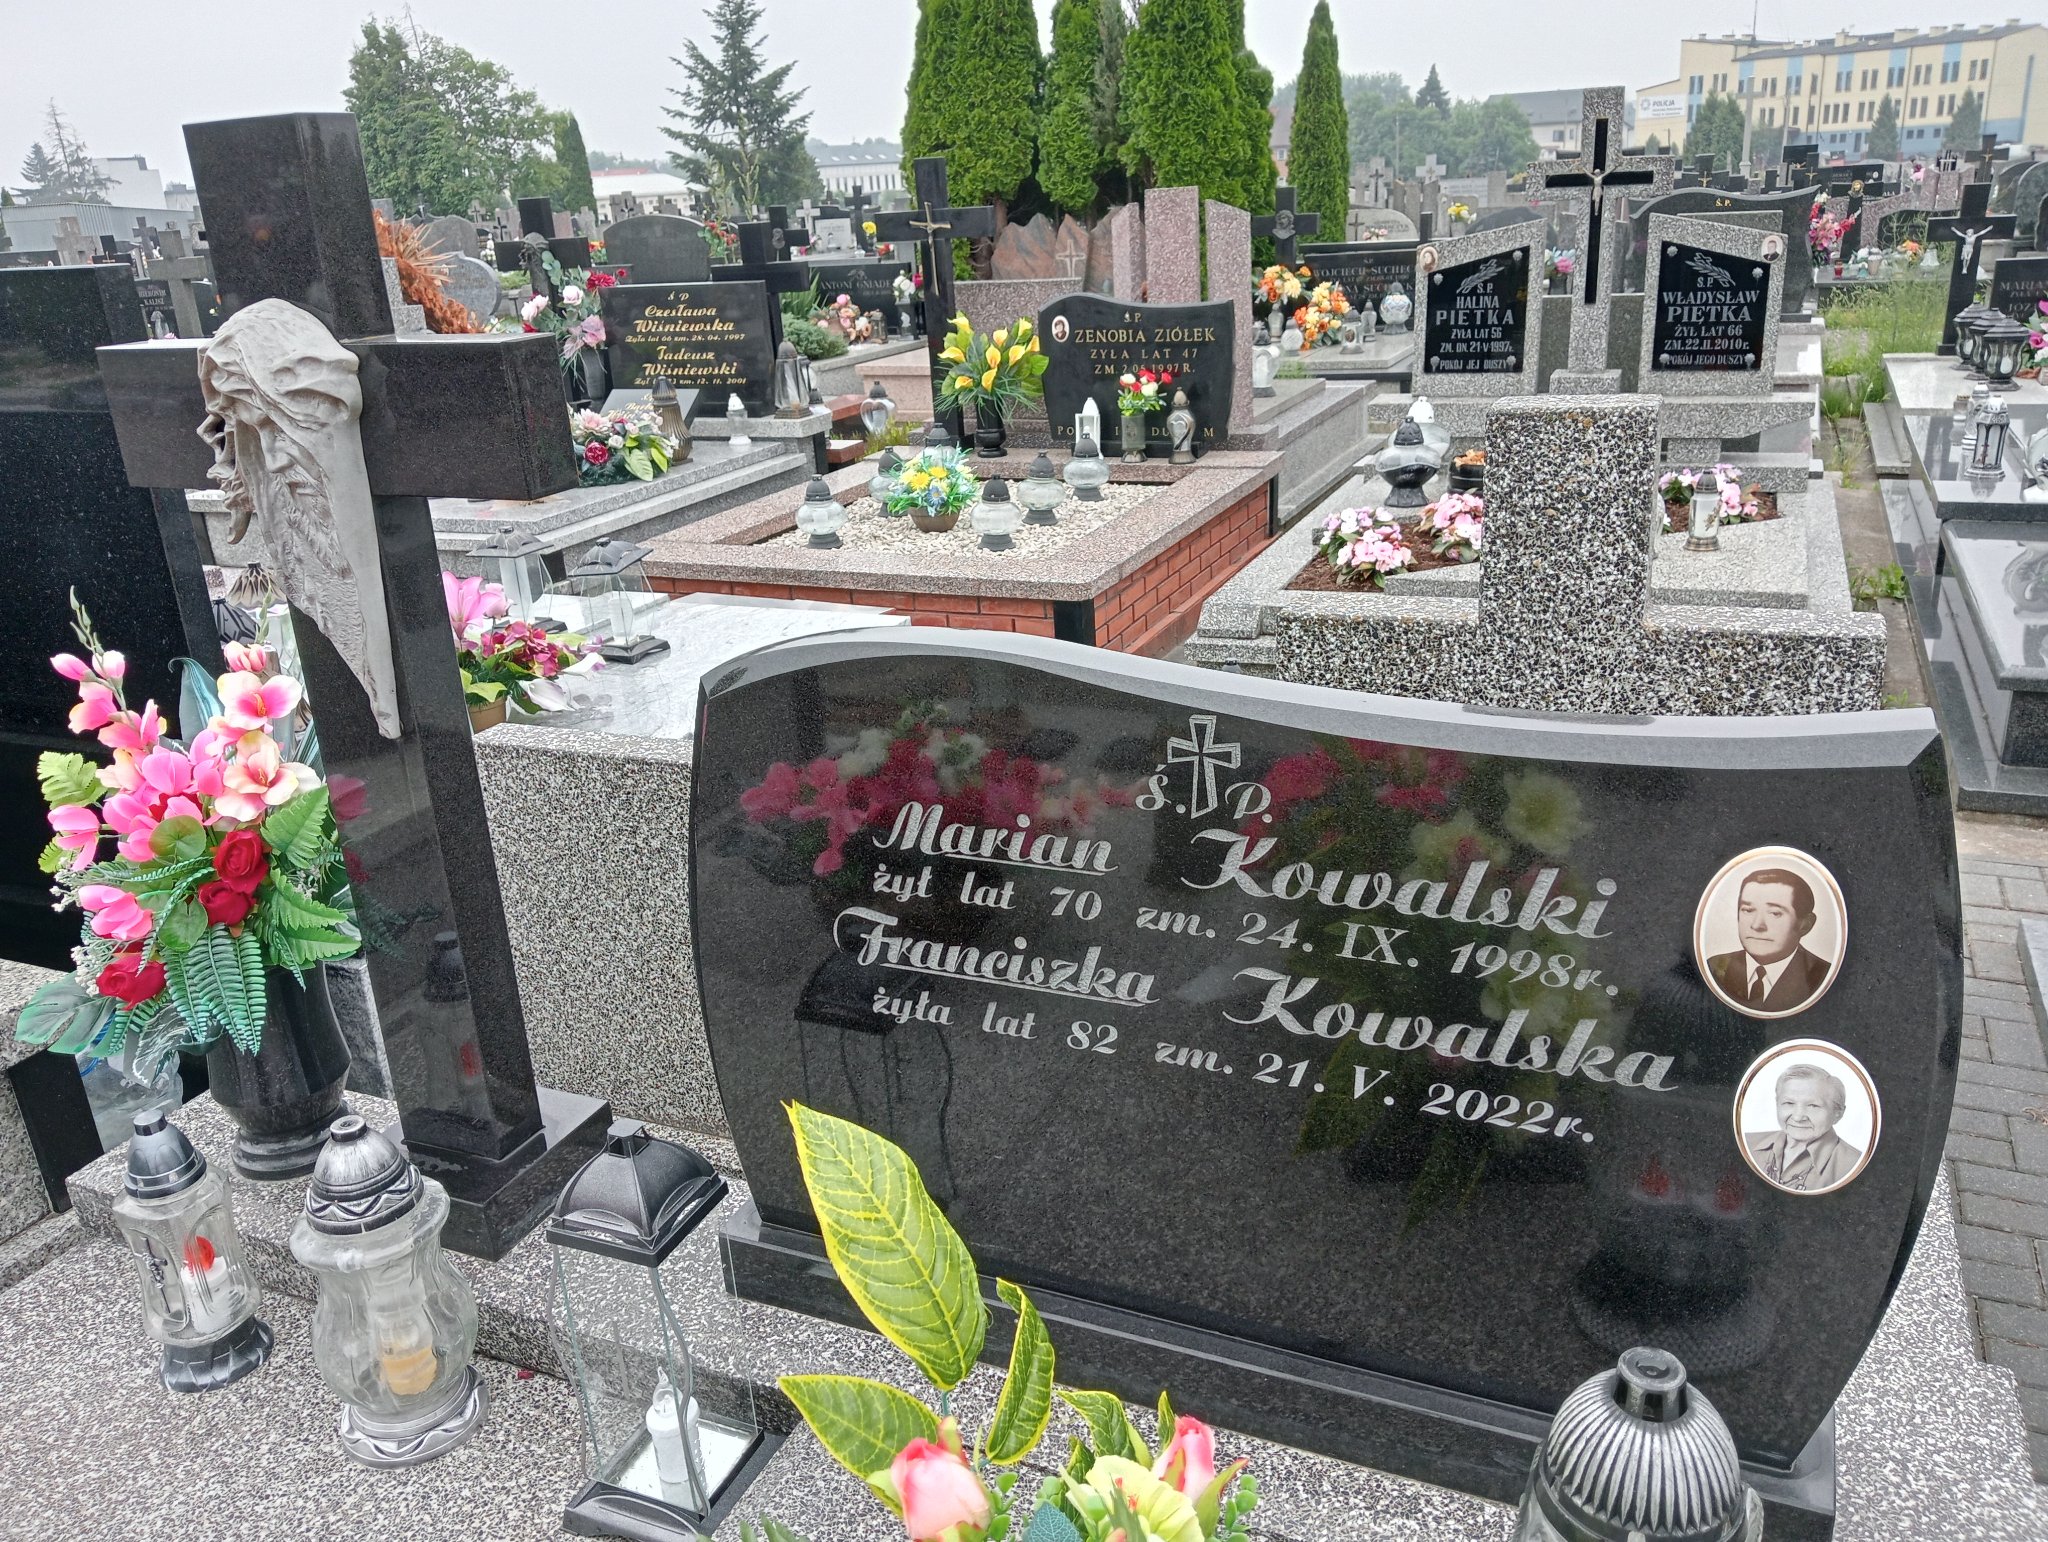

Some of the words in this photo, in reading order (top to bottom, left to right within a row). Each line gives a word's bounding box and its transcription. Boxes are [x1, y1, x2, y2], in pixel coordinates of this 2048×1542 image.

[1371, 264, 1413, 274] SUCHEC
[820, 280, 852, 290] ANTONI
[856, 280, 891, 288] GNIADE
[1456, 296, 1500, 308] HALINA
[1662, 290, 1760, 304] WŁADYSŁAW
[644, 304, 718, 318] Czesława
[1666, 305, 1752, 324] PIĘTKA
[633, 318, 736, 333] Wiśniewska
[1474, 328, 1490, 338] LAT
[1491, 326, 1502, 338] 56
[1674, 324, 1698, 337] ŻYŁ
[1700, 326, 1724, 337] LAT
[1728, 324, 1743, 336] 66
[1074, 328, 1146, 343] ZENOBIA
[1154, 326, 1216, 342] ZIÓŁEK
[656, 346, 716, 360] Tadeusz
[1141, 348, 1172, 359] LAT
[1182, 348, 1198, 358] 47
[1440, 342, 1454, 353] ZM.
[1466, 360, 1480, 370] JEJ
[1694, 354, 1716, 365] JEGO
[1717, 354, 1744, 365] DUSZY
[642, 362, 738, 376] Wiśniewski
[872, 801, 1119, 874] Marian
[1180, 828, 1619, 939] Kowalski
[872, 865, 934, 904] żył
[959, 869, 1017, 910] lat
[1049, 886, 1103, 921] 70
[1136, 906, 1217, 939] zm.
[1236, 911, 1315, 952] 24.
[1336, 922, 1420, 968] IX.
[1450, 941, 1620, 997] 1998r.
[832, 905, 1160, 1006] Franciszka
[1222, 966, 1680, 1093] Kowalska
[872, 986, 954, 1025] żyła
[982, 1001, 1038, 1040] lat
[1066, 1020, 1119, 1054] 82
[1155, 1041, 1234, 1075] zm.
[1252, 1052, 1326, 1094] 21.
[1352, 1064, 1396, 1107] V.
[1419, 1082, 1596, 1143] 2022r.
